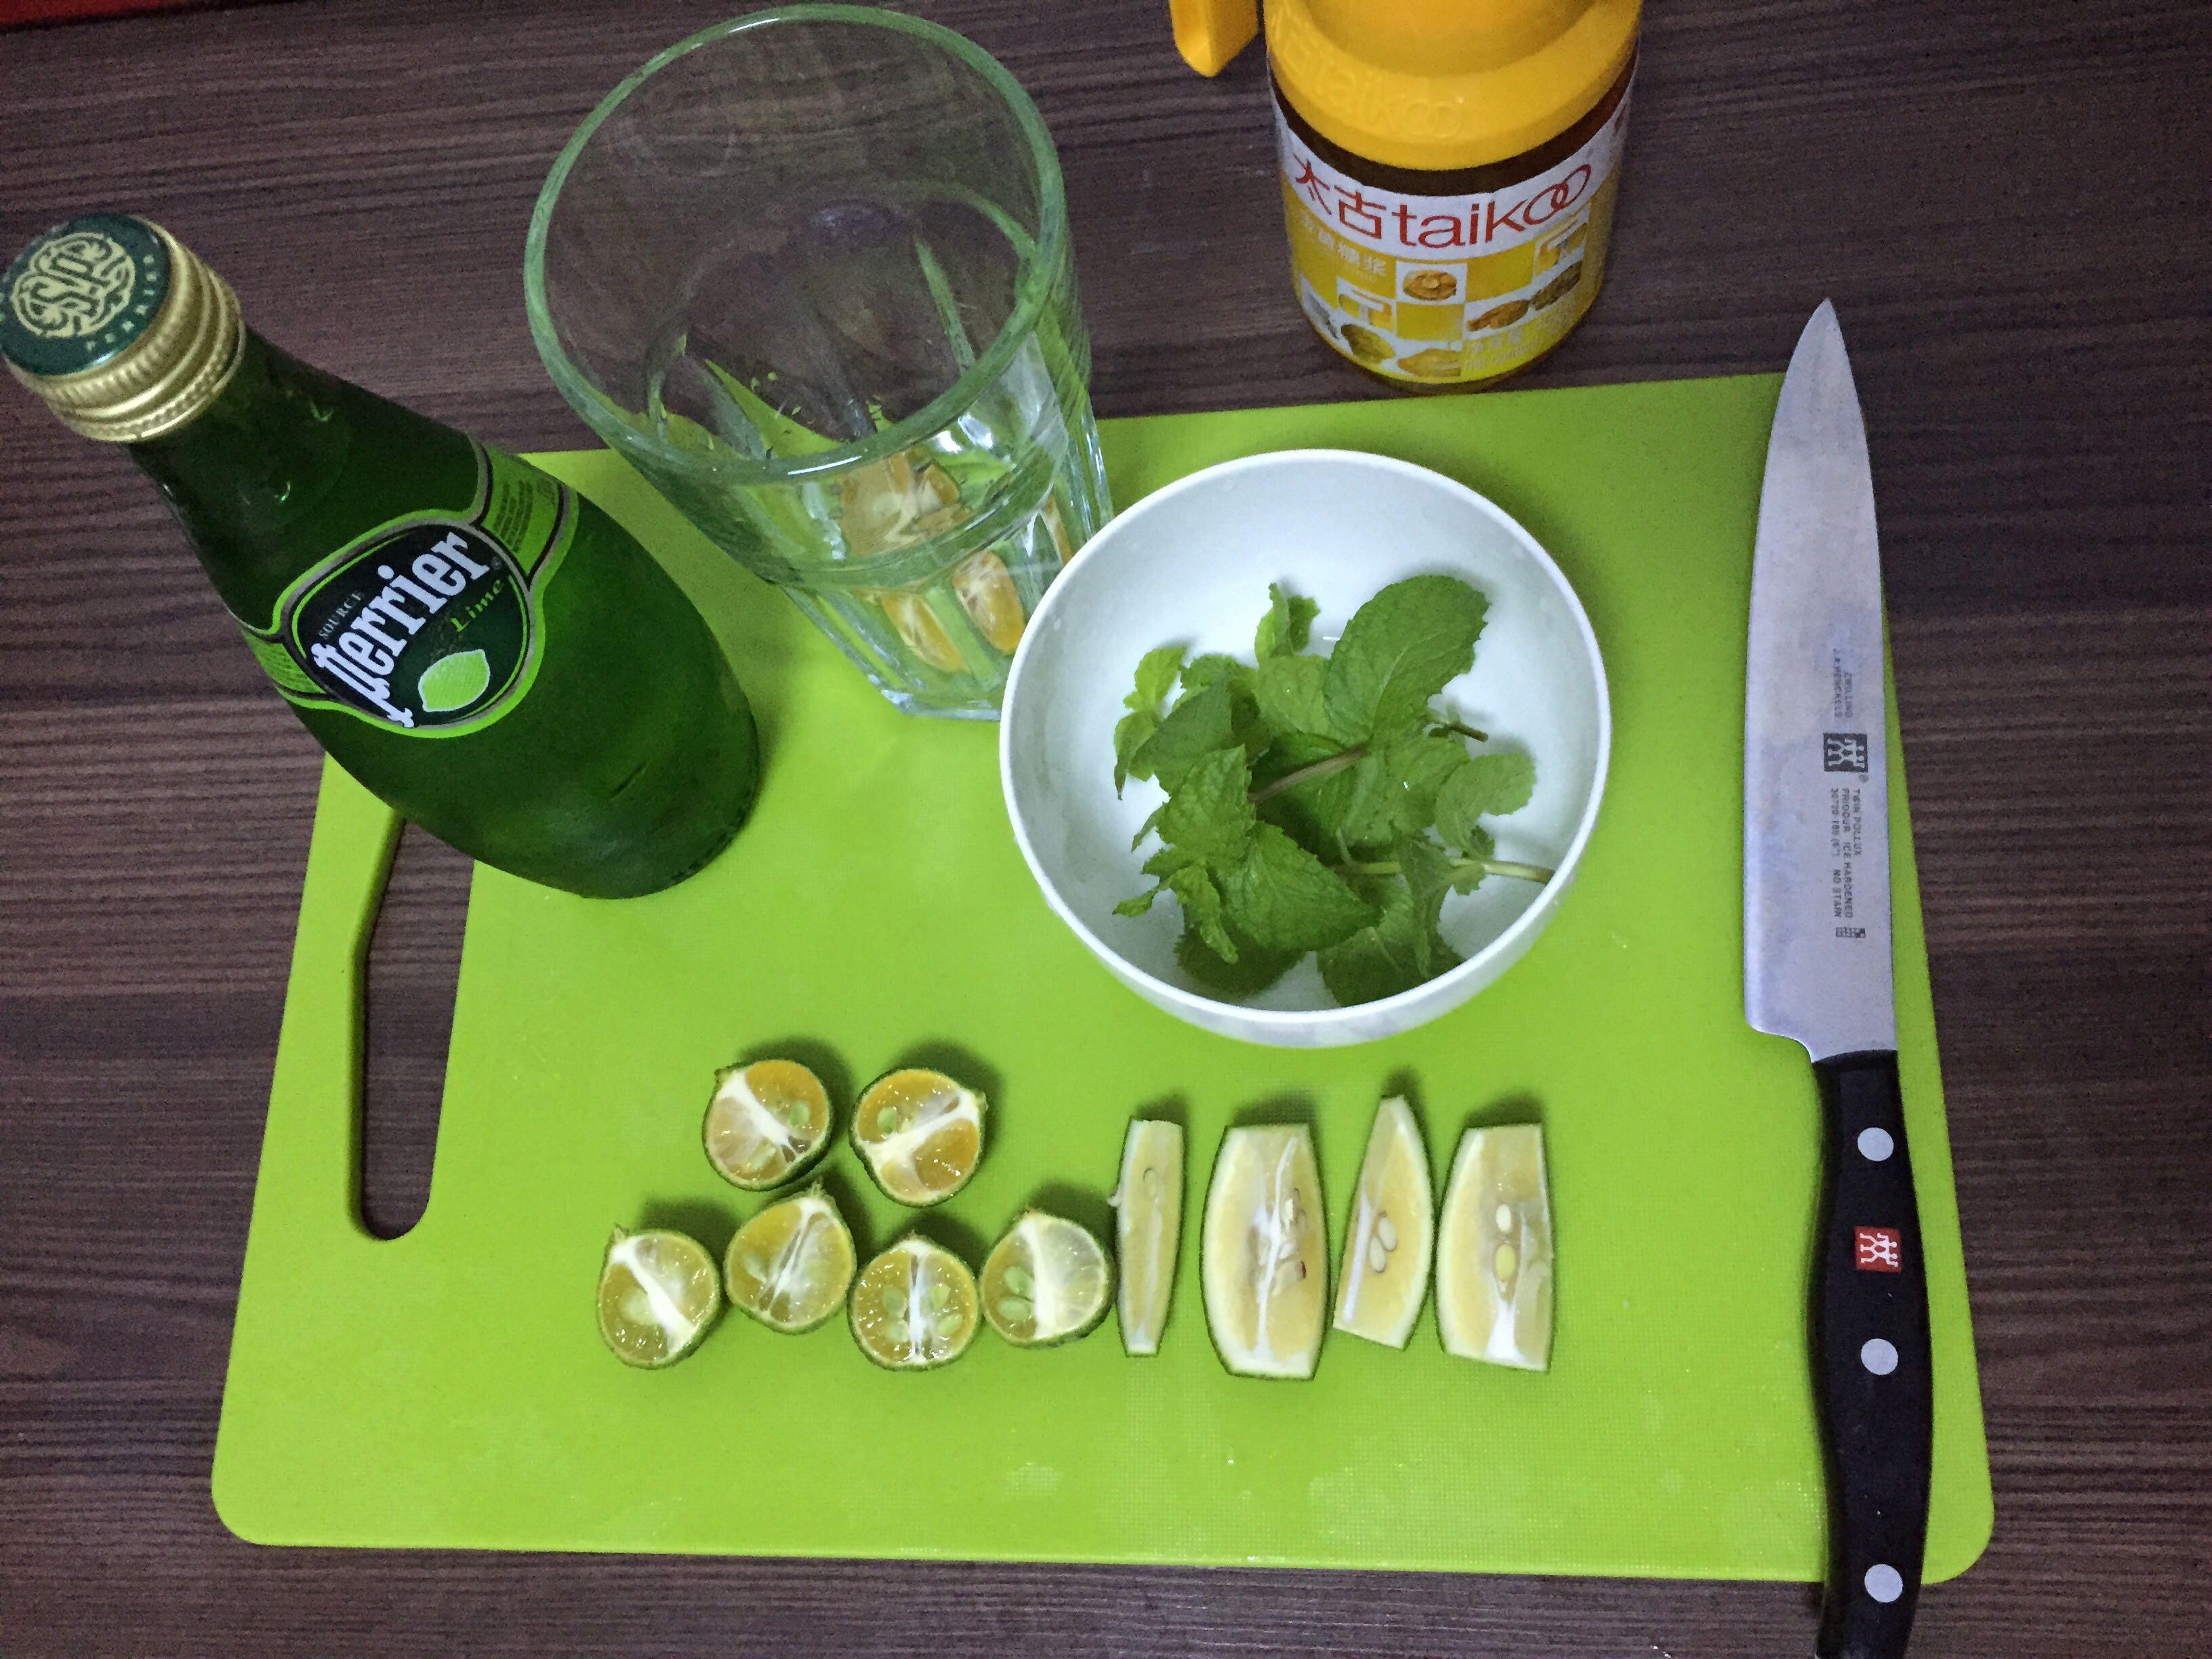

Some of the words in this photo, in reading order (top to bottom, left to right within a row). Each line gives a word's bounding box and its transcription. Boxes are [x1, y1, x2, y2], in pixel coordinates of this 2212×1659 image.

[1293, 153, 1387, 239] 太古
[318, 590, 365, 639] SOURCE
[450, 579, 504, 633] Lime
[1844, 862, 1853, 918] HARDENED
